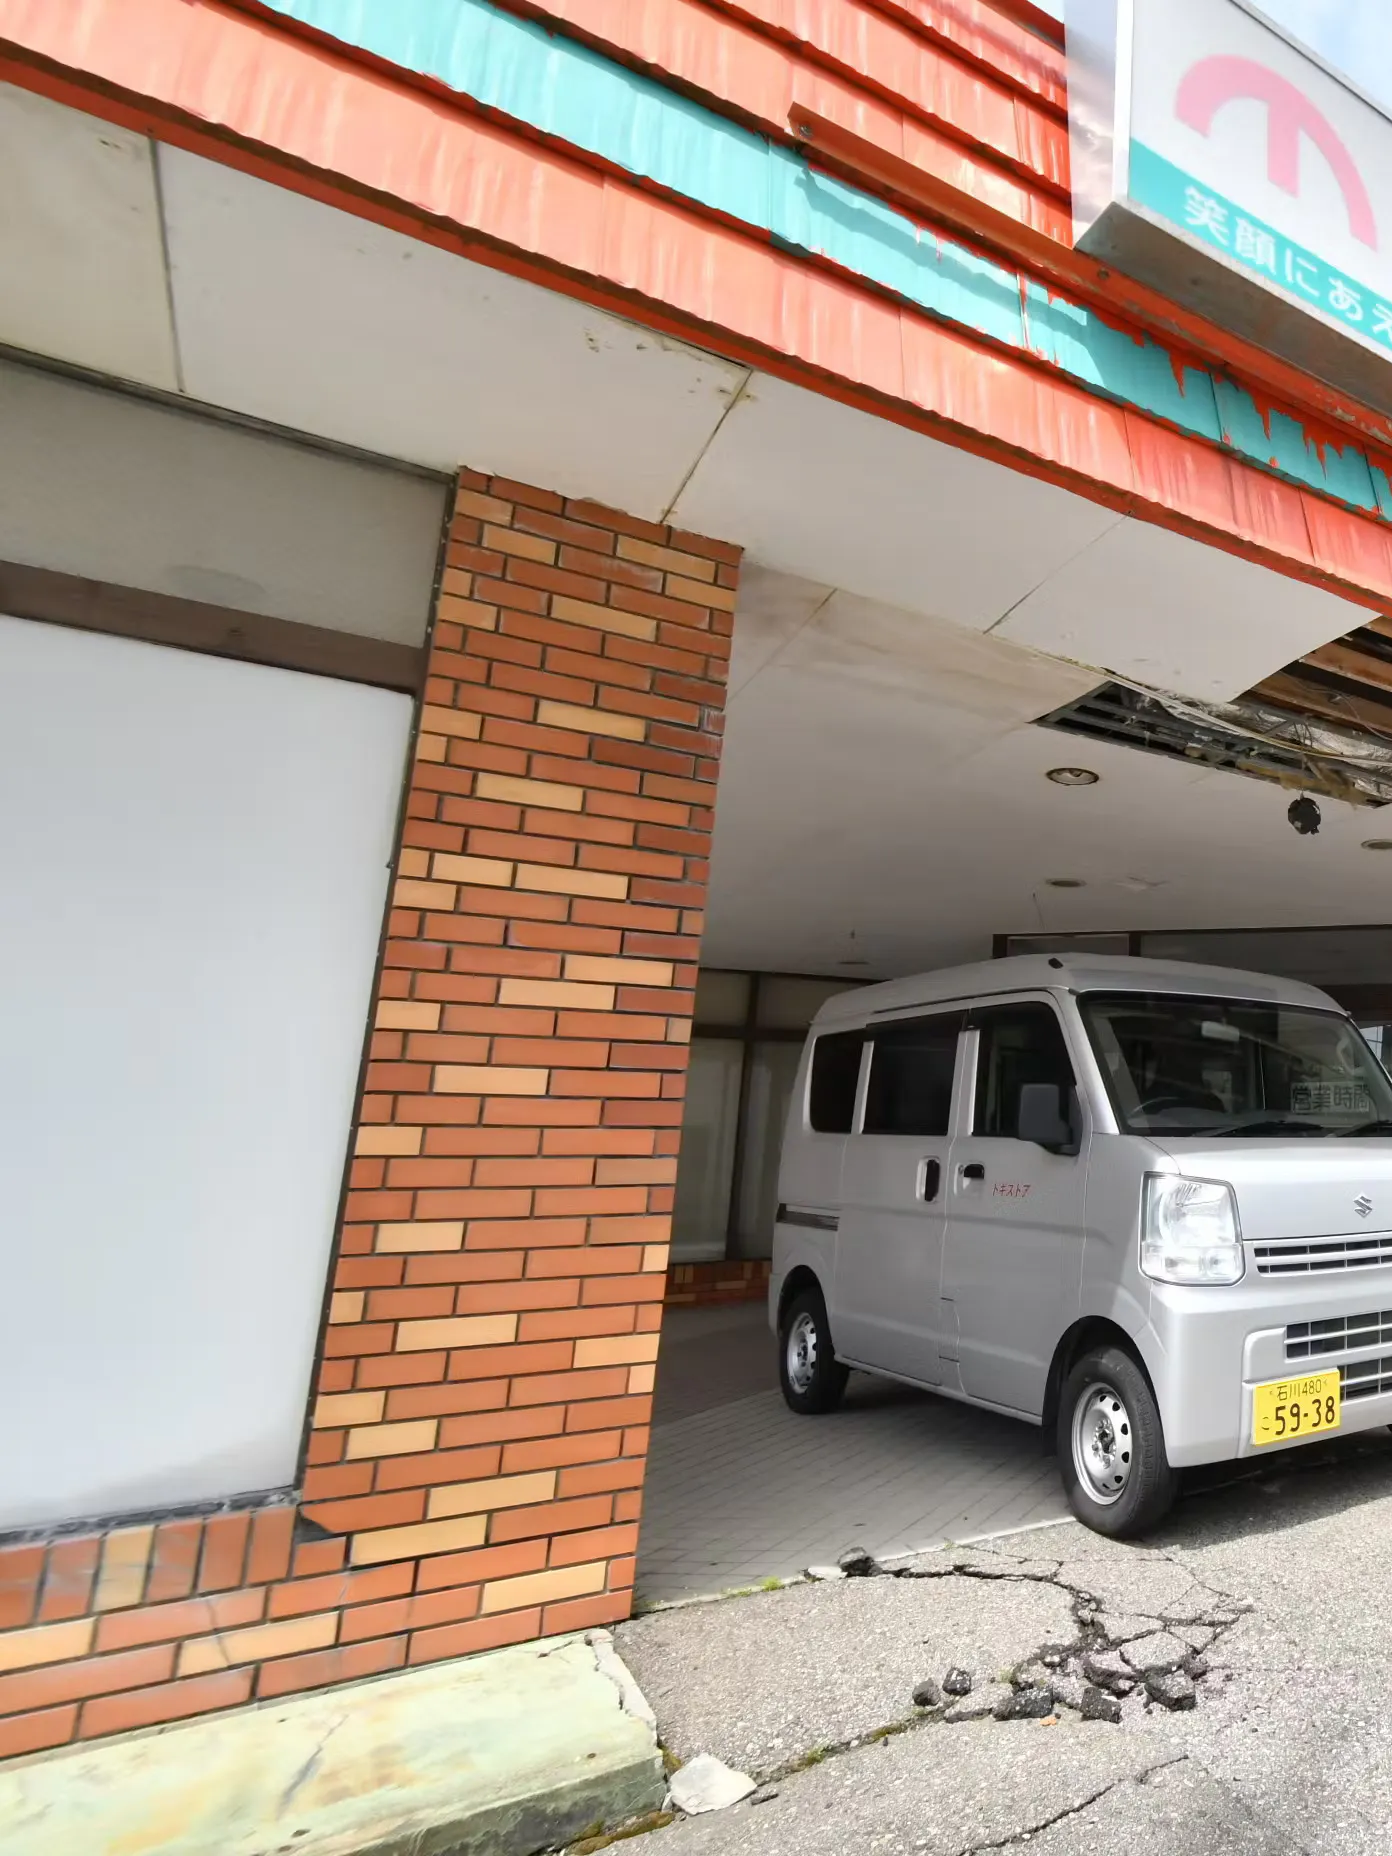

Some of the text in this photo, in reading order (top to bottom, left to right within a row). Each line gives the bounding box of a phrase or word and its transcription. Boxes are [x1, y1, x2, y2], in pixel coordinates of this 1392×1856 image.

[993, 1184, 1031, 1197] トギストア
[1262, 1396, 1335, 1436] こ 59-38
